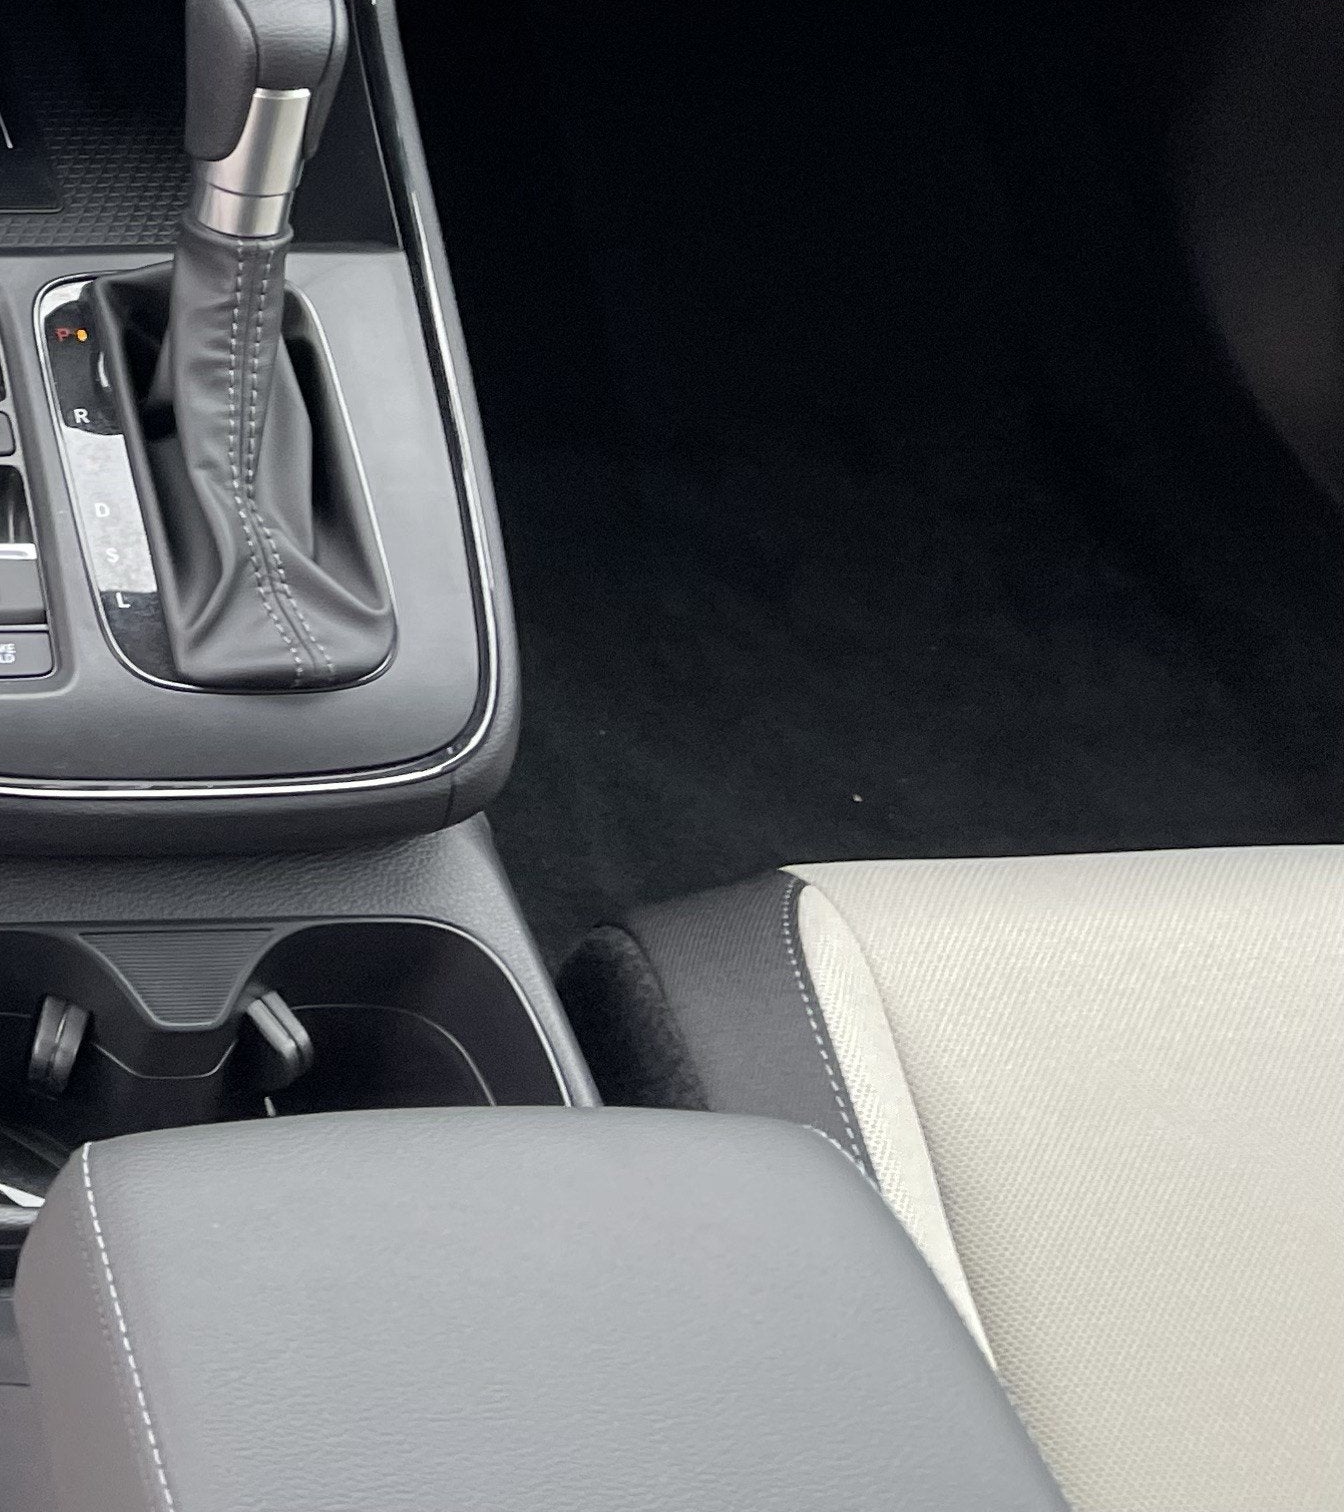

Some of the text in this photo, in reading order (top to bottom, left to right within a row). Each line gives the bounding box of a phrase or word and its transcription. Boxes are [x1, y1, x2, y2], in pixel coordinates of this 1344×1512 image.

[56, 328, 72, 342] P
[73, 408, 90, 424] R
[94, 502, 110, 517] D
[105, 547, 120, 563] S
[115, 591, 131, 609] L
